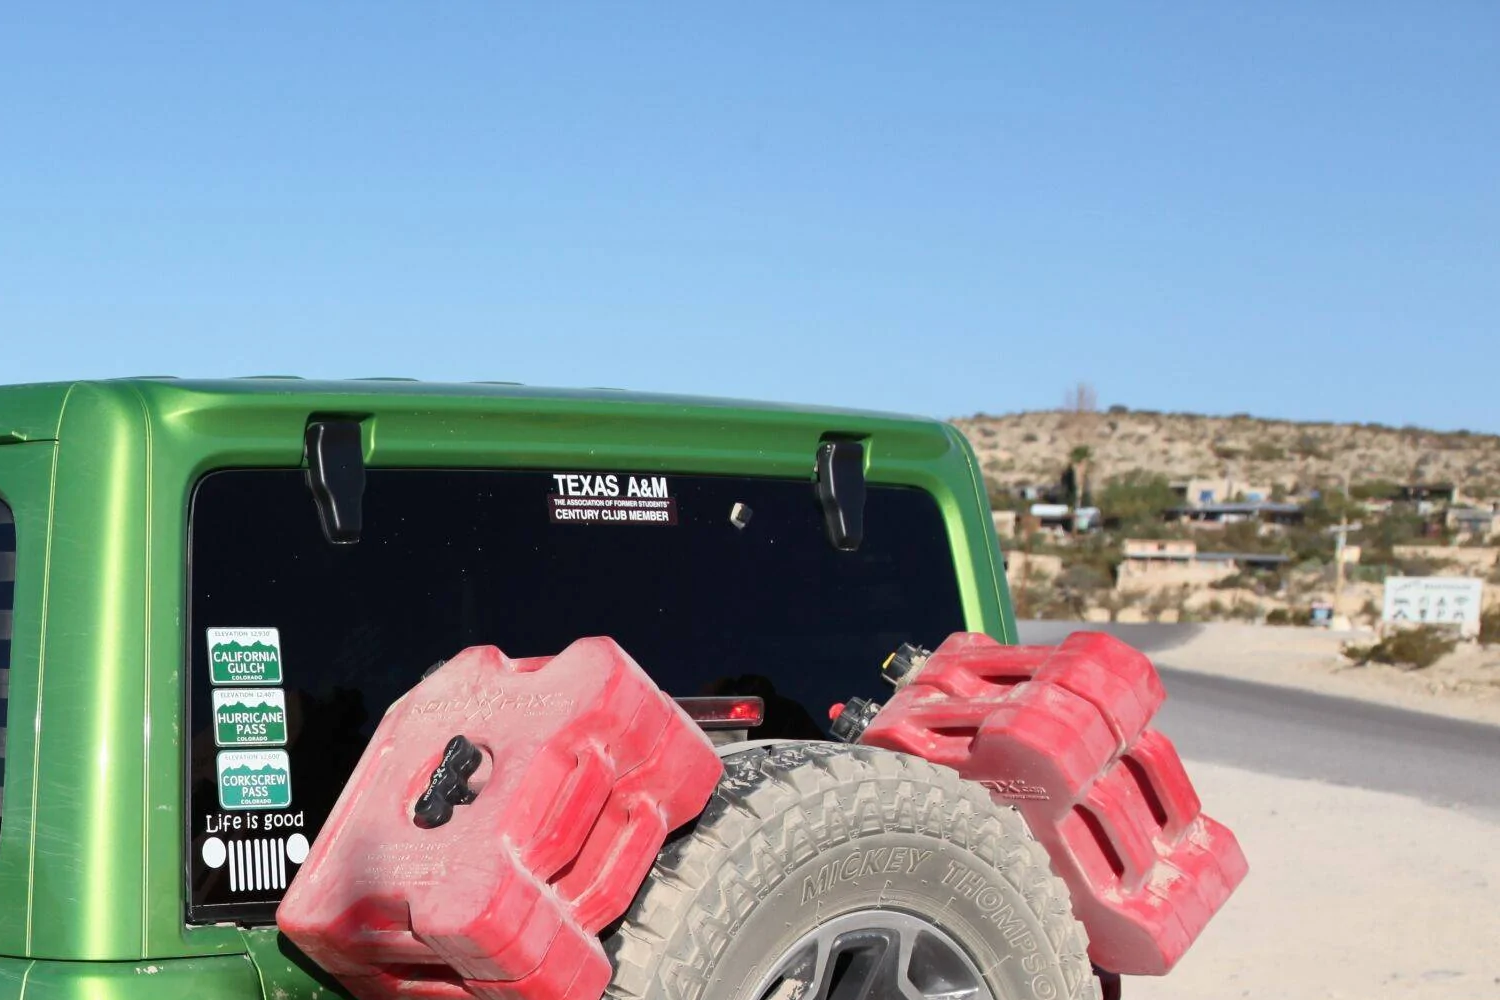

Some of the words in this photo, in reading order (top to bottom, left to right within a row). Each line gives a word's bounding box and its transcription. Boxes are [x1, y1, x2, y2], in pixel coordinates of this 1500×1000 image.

[553, 474, 620, 497] TEXAS
[627, 476, 669, 498] A&M
[567, 499, 604, 507] ASSOCIATION
[614, 500, 638, 508] FORMER
[555, 508, 600, 520] CENTURY
[601, 509, 628, 521] CLUB
[628, 510, 669, 521] MEMBER
[213, 651, 277, 662] CALIFORNIA
[227, 663, 265, 674] GULCH
[217, 712, 284, 724] HURRICANE
[236, 724, 267, 735] PASS
[222, 774, 286, 786] CORKSCREW
[241, 786, 269, 797] PASS
[206, 813, 242, 833] Life
[246, 812, 259, 828] is
[263, 810, 304, 830] good
[801, 847, 933, 906] MICKEY
